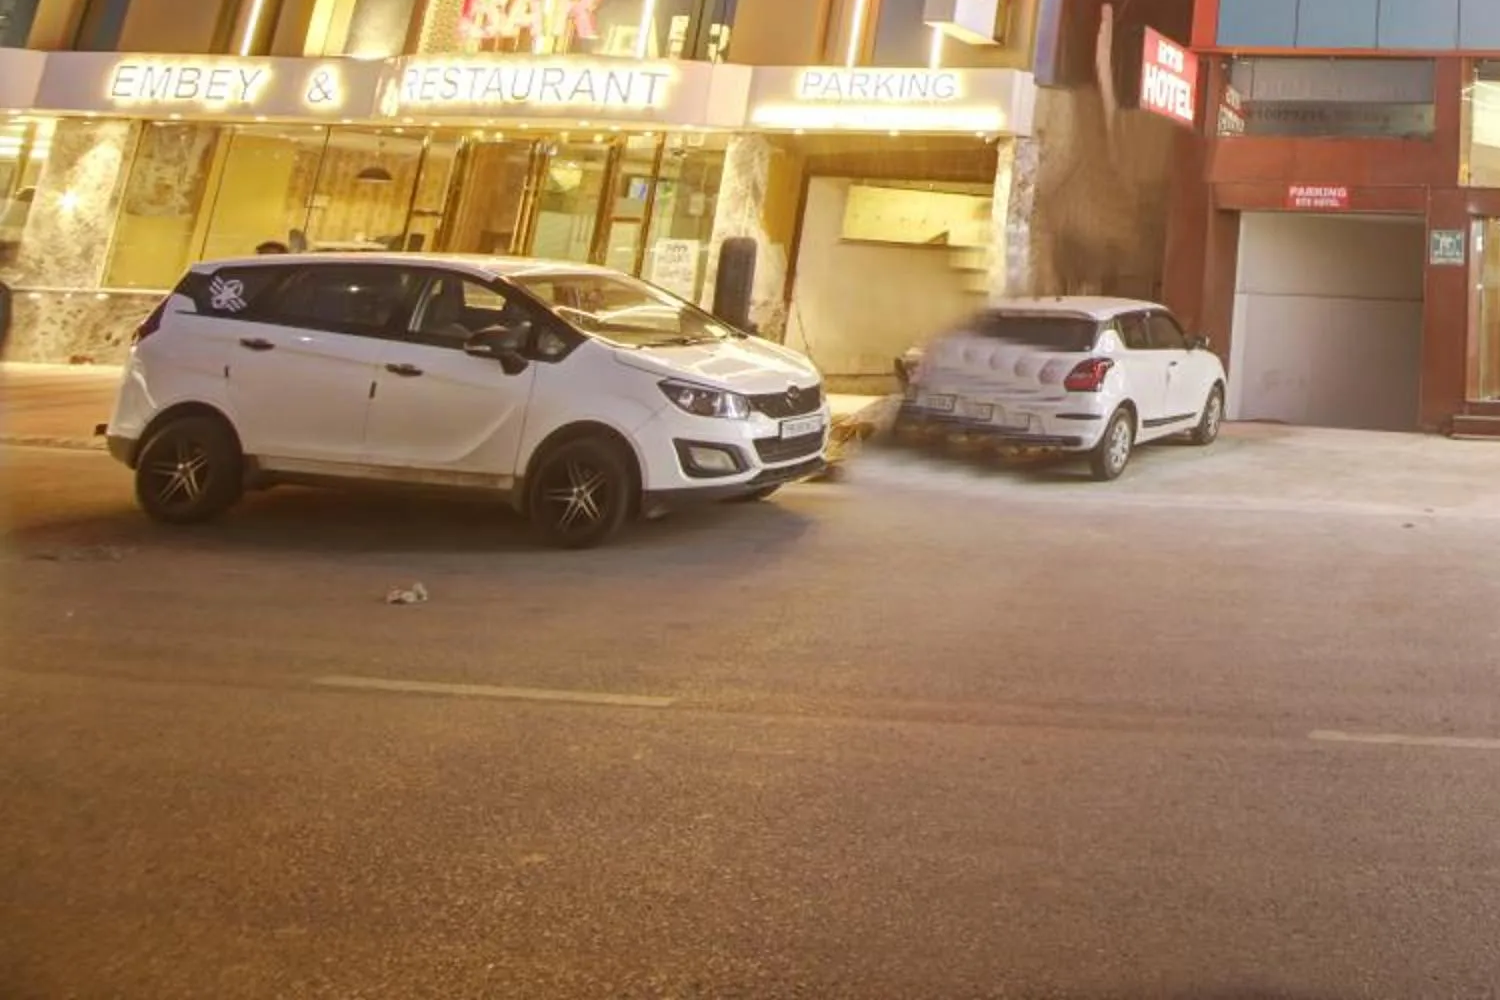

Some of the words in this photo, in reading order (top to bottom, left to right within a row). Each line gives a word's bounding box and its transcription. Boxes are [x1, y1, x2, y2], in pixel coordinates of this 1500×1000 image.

[112, 65, 262, 102] EMBEY
[307, 71, 333, 103] &
[405, 66, 669, 105] RESTAURANT
[803, 71, 956, 101] PARKING
[1143, 62, 1194, 121] HOTEL
